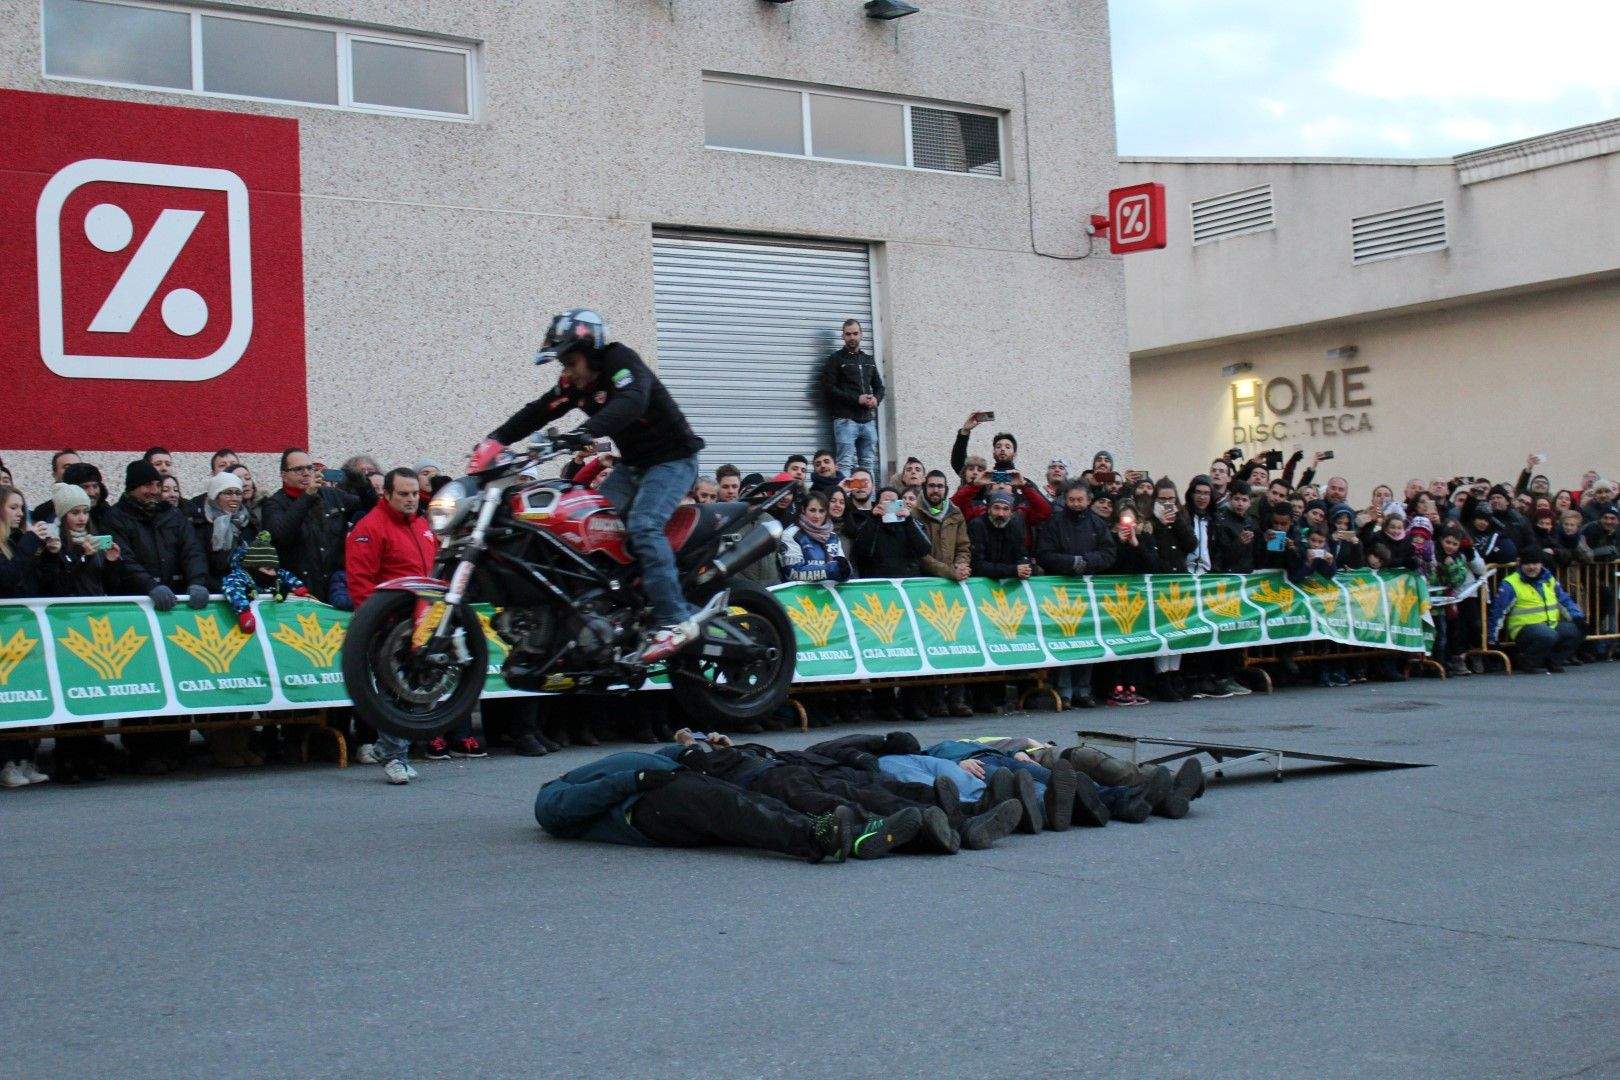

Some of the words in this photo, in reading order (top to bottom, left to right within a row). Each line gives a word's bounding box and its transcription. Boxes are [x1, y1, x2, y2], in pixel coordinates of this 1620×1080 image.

[1231, 366, 1372, 420] HOME
[796, 651, 820, 662] CAJA
[819, 649, 853, 661] RURAL
[863, 649, 887, 659] CAJA
[886, 647, 918, 658] RURAL
[926, 645, 950, 656] CAJA
[179, 679, 216, 692] CAJA
[217, 676, 267, 690] RURAL
[284, 673, 320, 686] CAJA
[0, 689, 48, 704] RURAL
[67, 685, 106, 699] CAJA
[108, 682, 160, 697] RURAL
